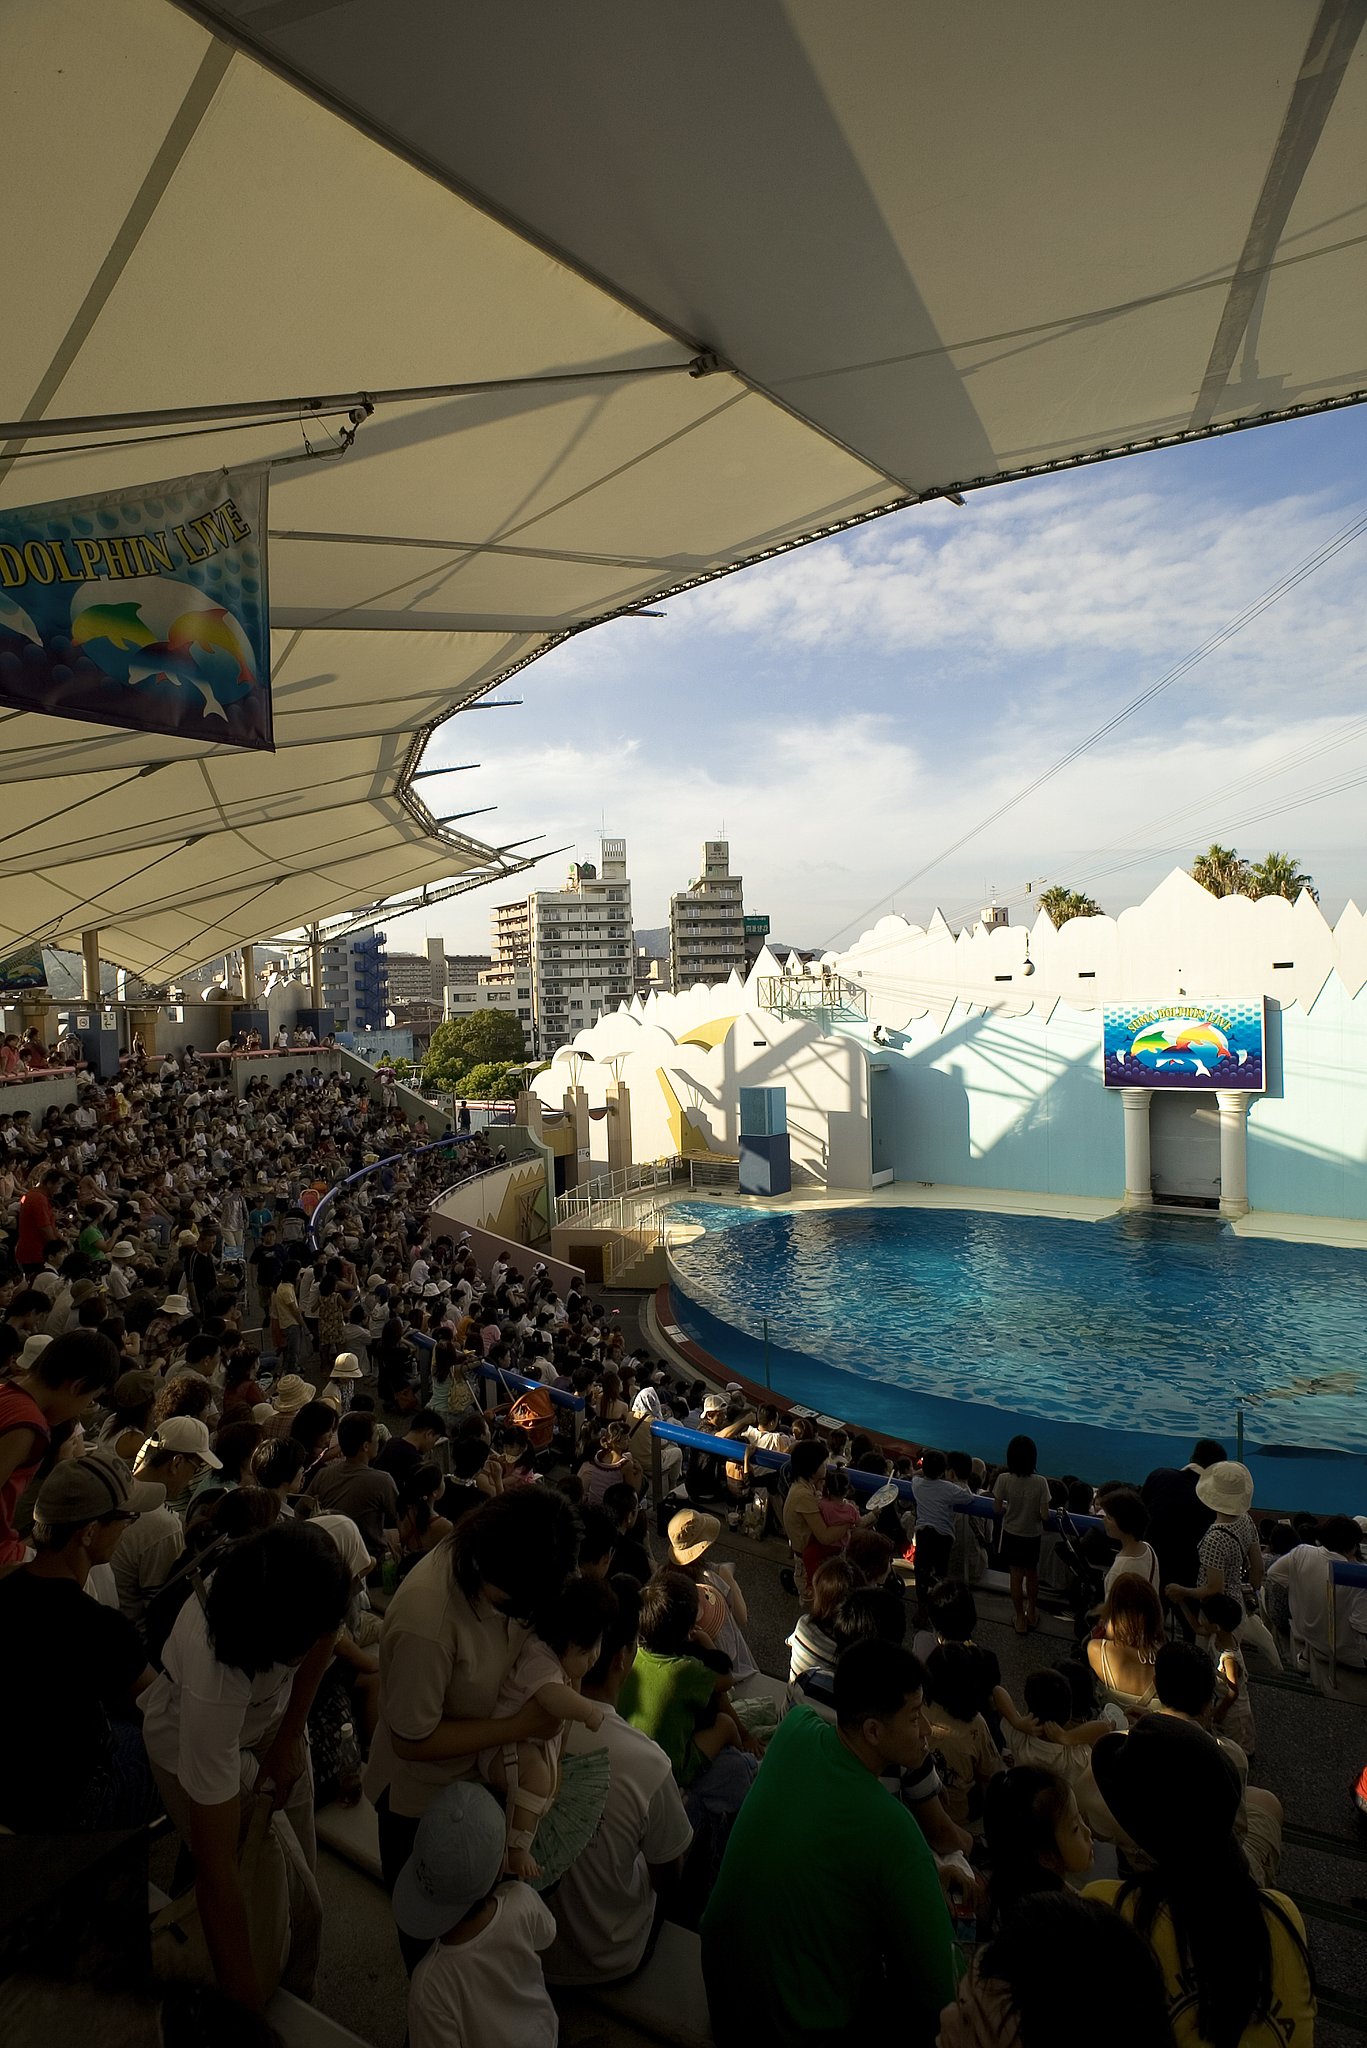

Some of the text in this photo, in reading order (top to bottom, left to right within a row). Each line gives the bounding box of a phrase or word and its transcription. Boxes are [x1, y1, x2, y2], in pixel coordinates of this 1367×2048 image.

[0, 499, 251, 588] DOLPHIN LIVE
[1127, 1006, 1233, 1033] SUMA DOLPHIN LIVE
